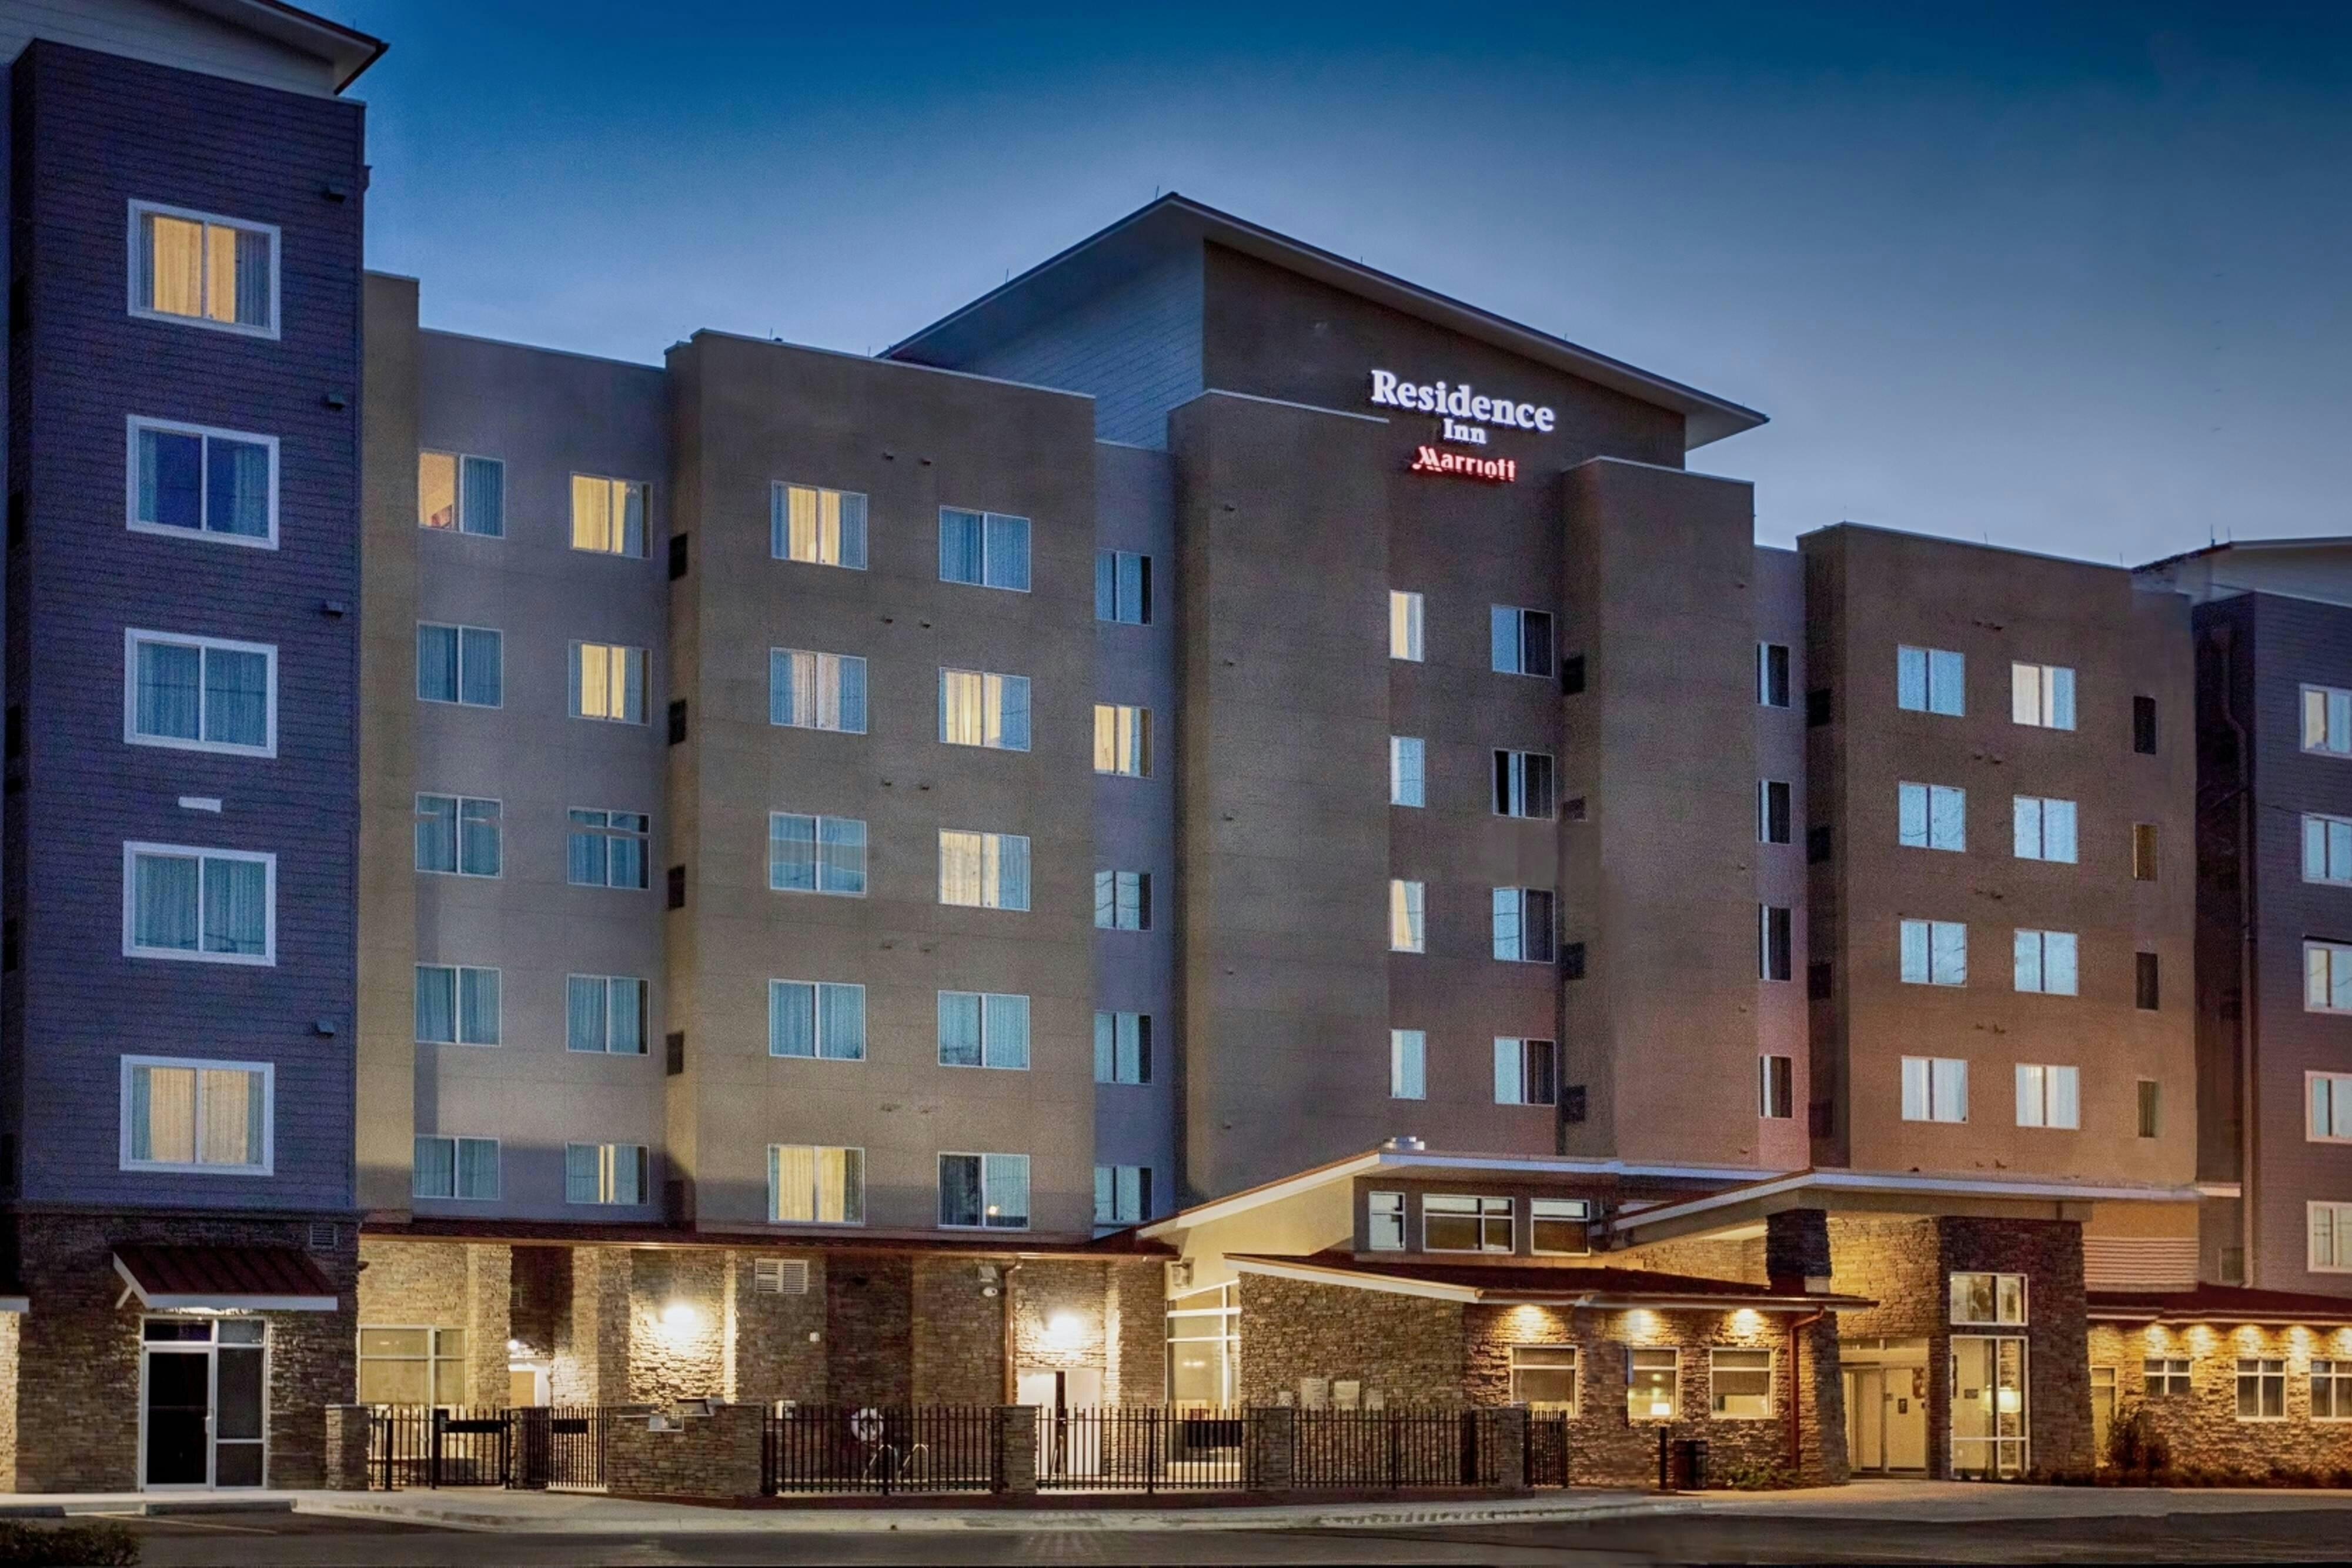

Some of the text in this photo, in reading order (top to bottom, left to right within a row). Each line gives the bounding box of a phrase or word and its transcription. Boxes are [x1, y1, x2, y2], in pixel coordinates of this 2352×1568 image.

[1371, 370, 1555, 432] Residence
[1443, 418, 1486, 444] Inn
[1412, 446, 1515, 482] Marriott
